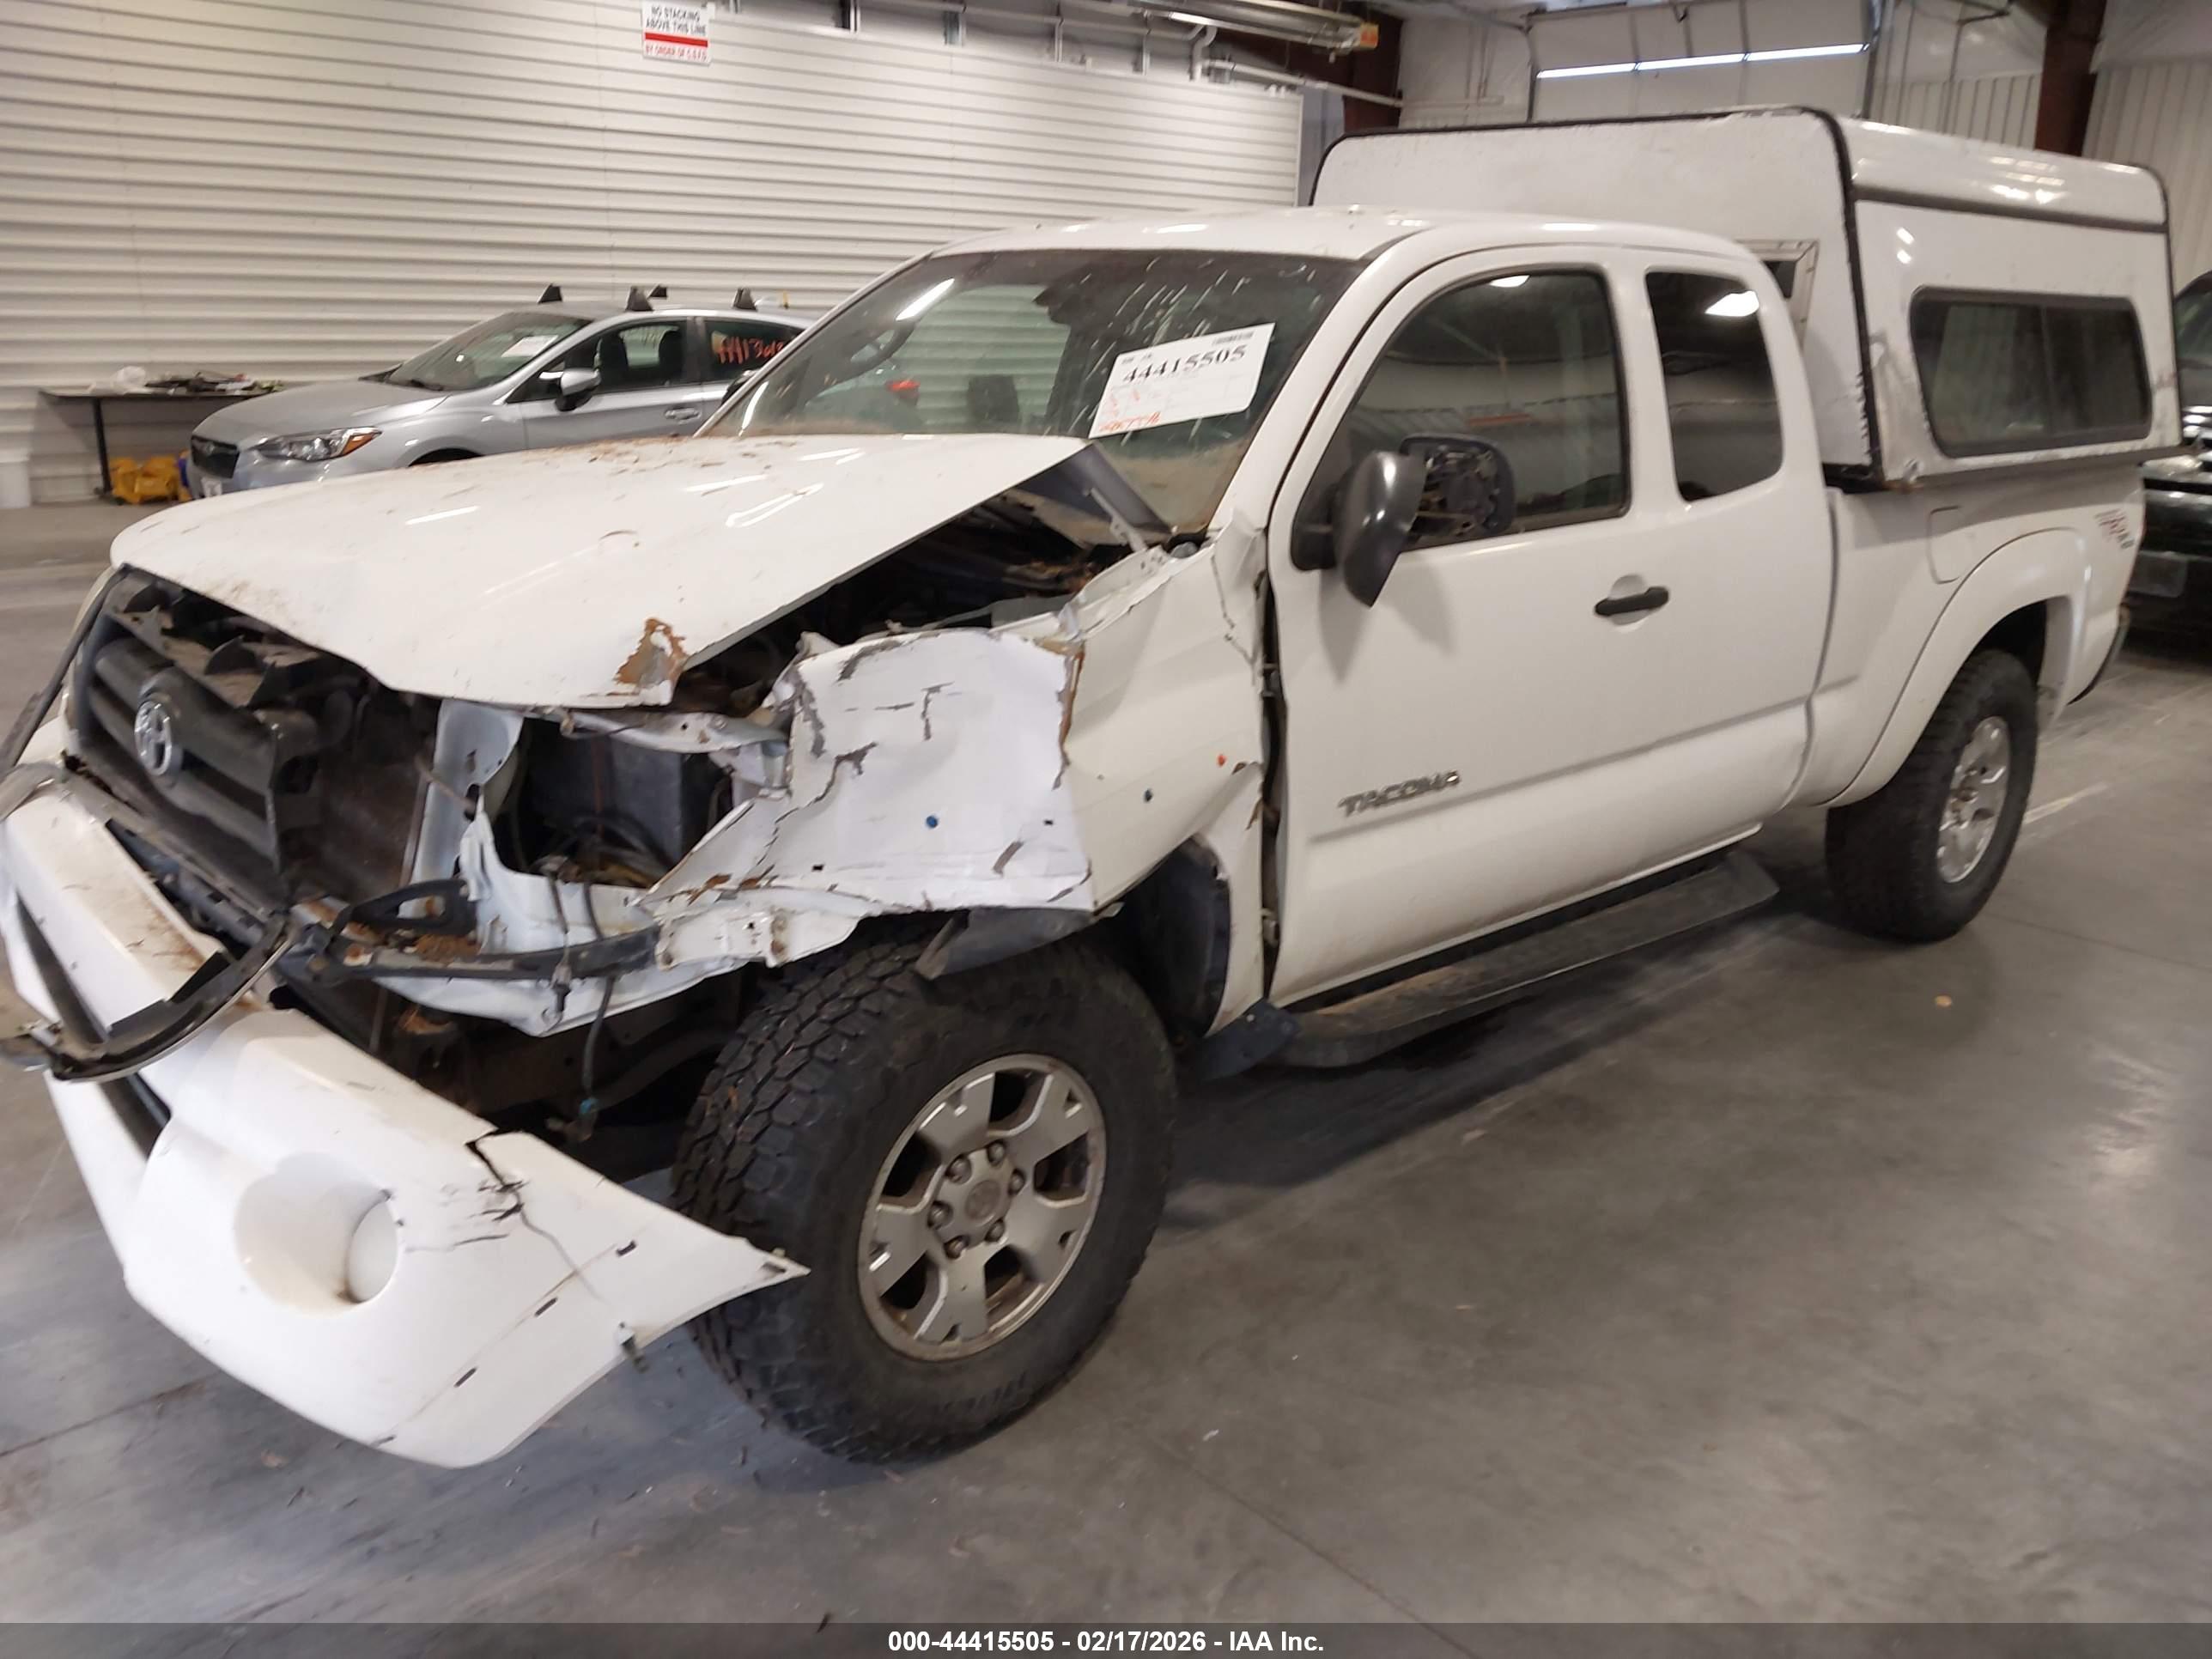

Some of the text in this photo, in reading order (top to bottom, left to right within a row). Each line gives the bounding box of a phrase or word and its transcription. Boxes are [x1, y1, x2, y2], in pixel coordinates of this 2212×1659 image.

[646, 18, 706, 35] ABOVE THIS LINE
[651, 5, 701, 22] NO STACKING
[1122, 343, 1249, 383] 44415505
[1337, 769, 1462, 817] TACOMA
